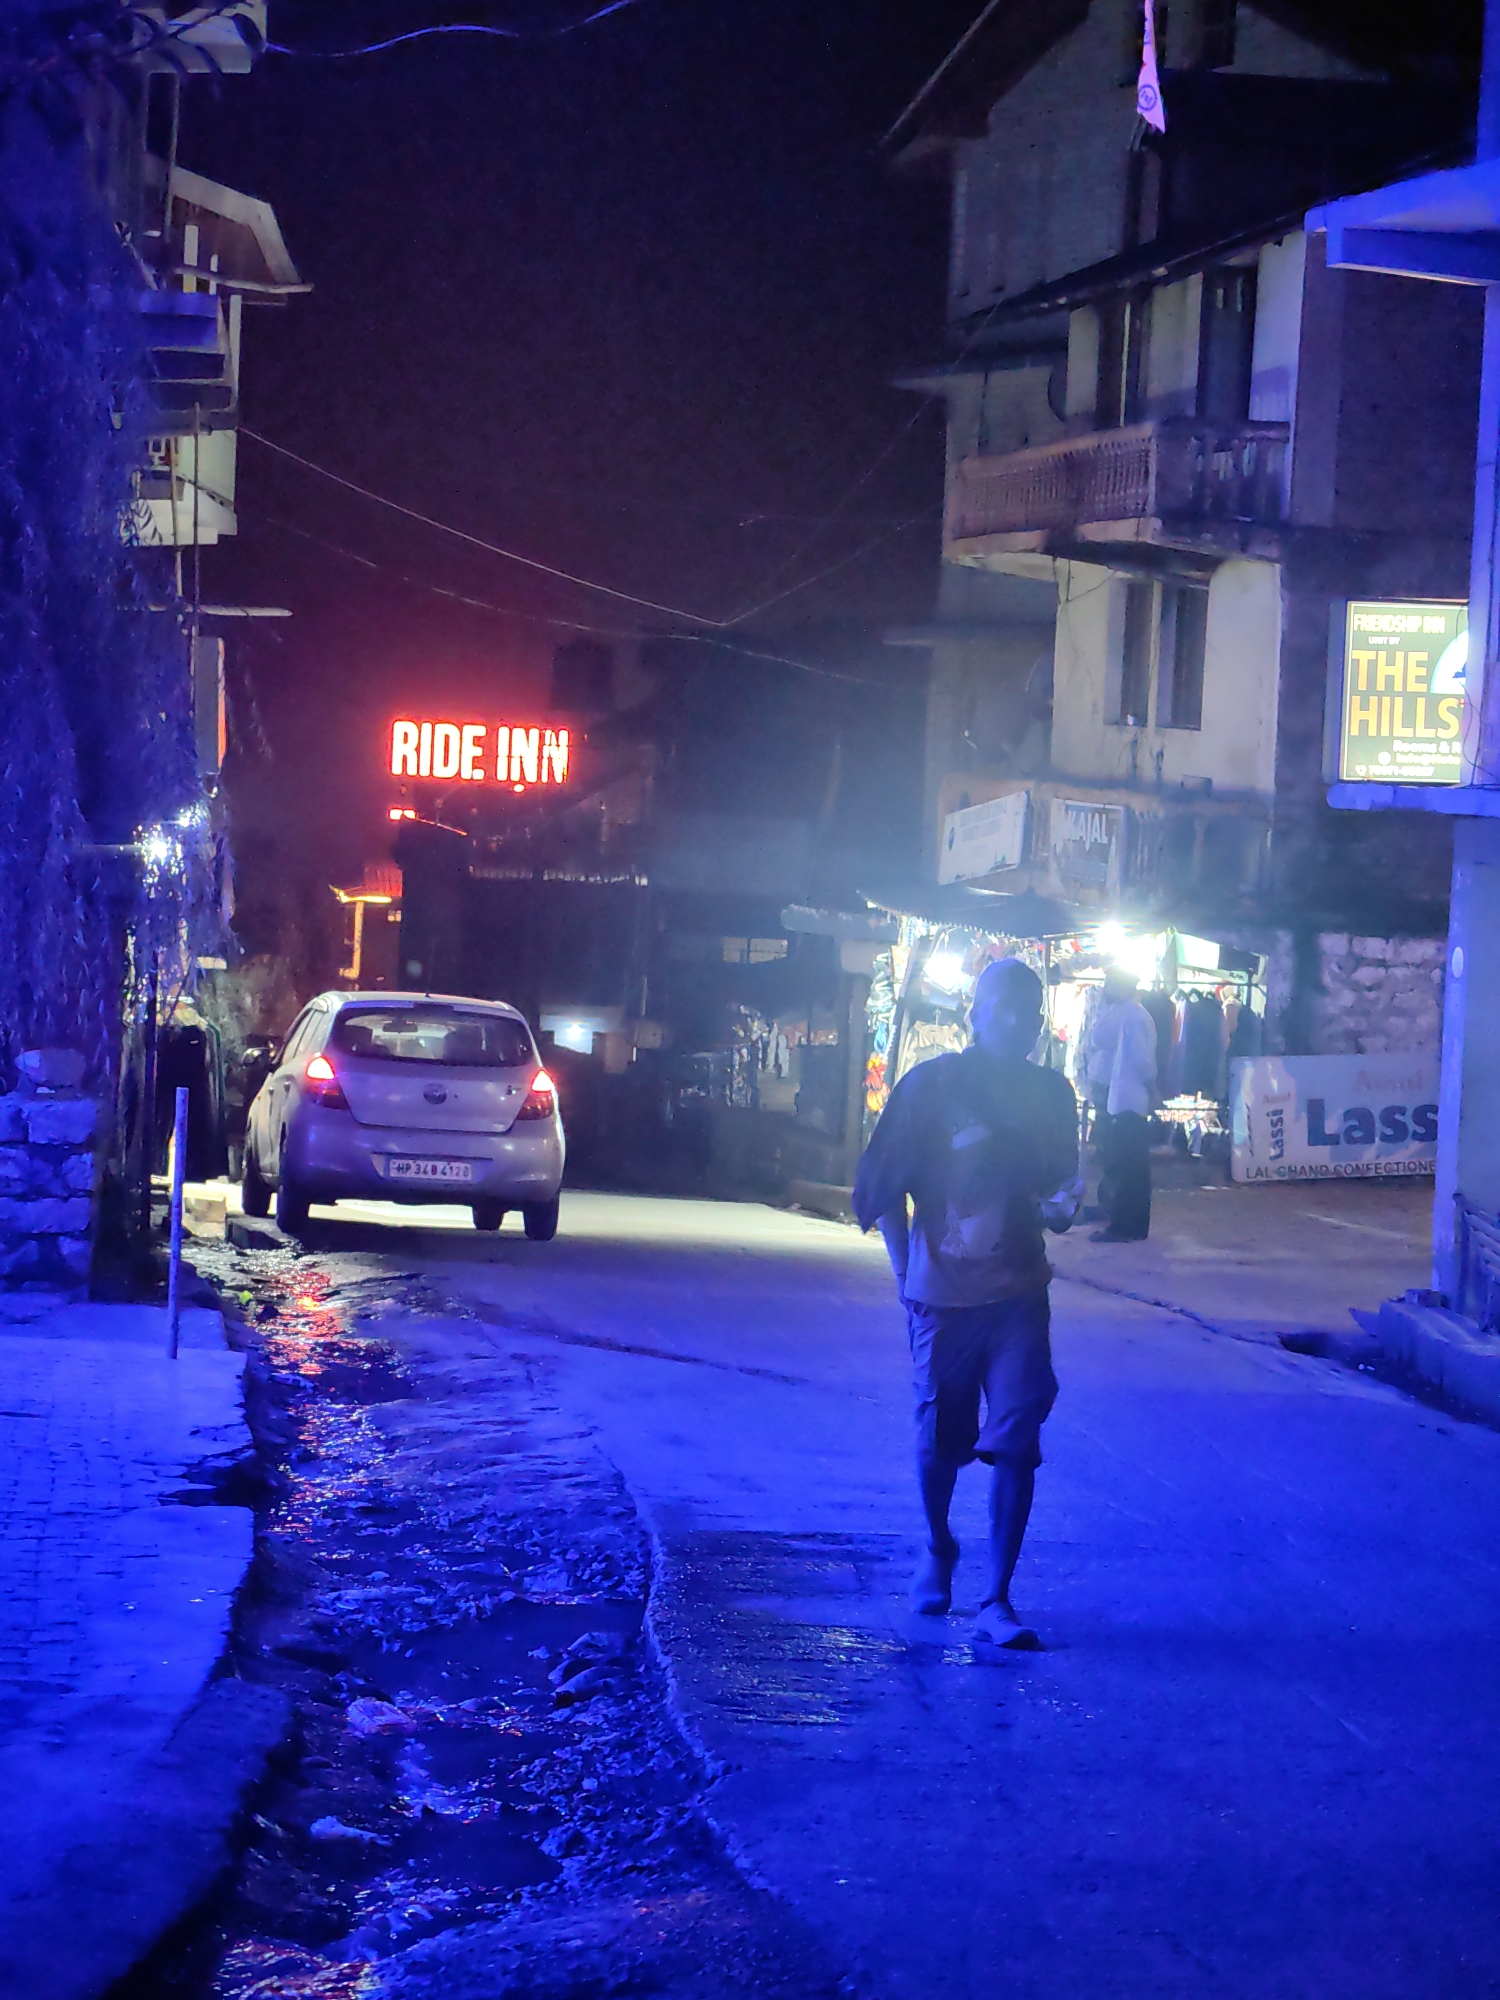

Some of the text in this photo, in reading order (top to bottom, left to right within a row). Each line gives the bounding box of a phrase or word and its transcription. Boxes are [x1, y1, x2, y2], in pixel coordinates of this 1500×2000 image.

[1353, 614, 1446, 634] FRIENDSHIP INN
[1352, 650, 1429, 693] THE
[1350, 695, 1464, 739] HILLS
[392, 721, 570, 784] RIDE INN
[1393, 740, 1438, 753] Rooms
[1265, 1107, 1284, 1161] Lassi
[1246, 1166, 1271, 1180] LAL
